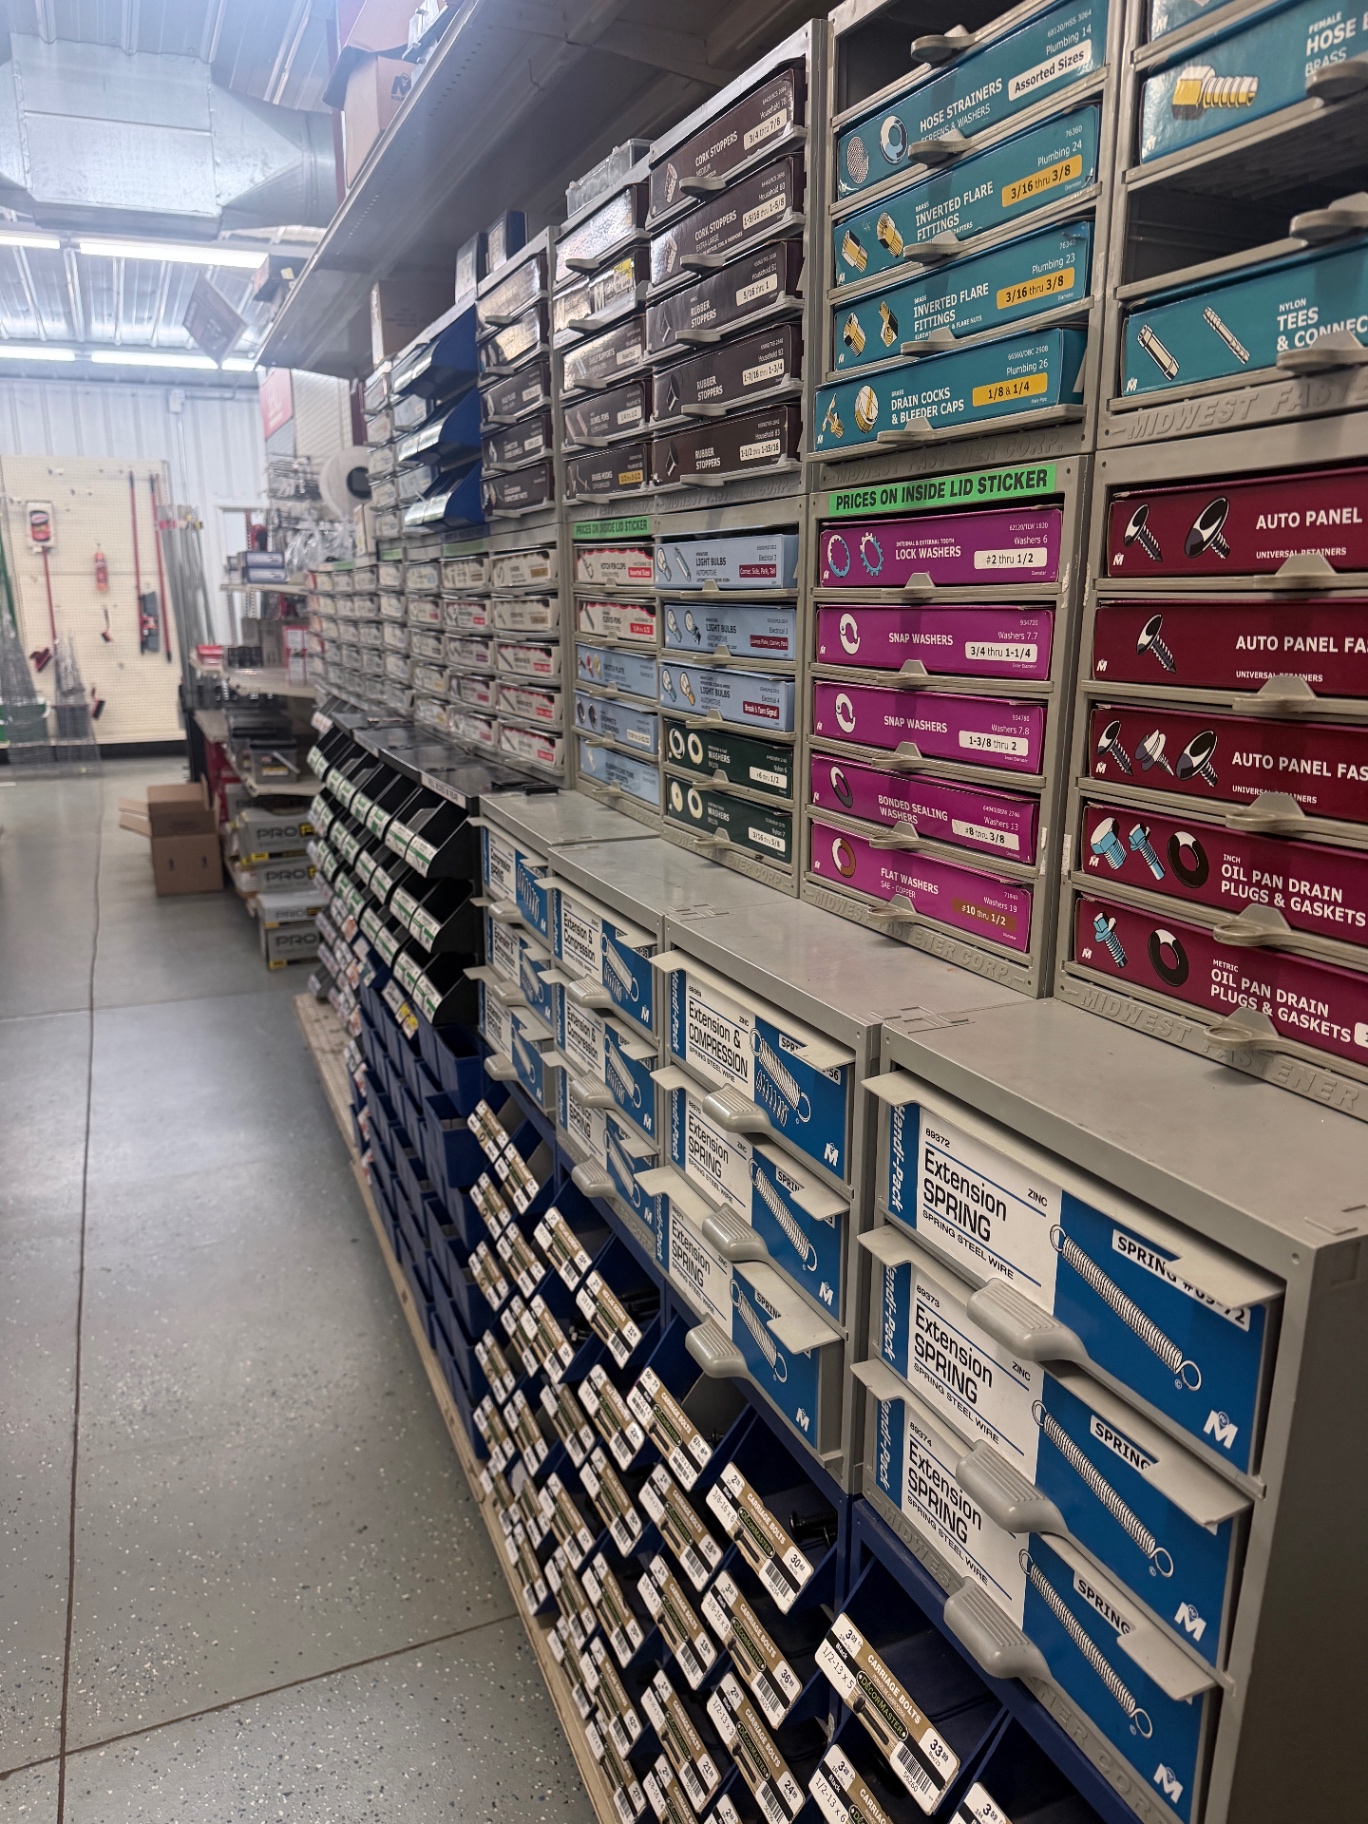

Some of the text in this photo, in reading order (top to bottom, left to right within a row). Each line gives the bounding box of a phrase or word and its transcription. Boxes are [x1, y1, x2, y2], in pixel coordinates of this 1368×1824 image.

[1309, 11, 1342, 34] FEMALE
[1046, 24, 1092, 55] Plumbing 14
[1306, 19, 1356, 56] HOSE
[1015, 50, 1084, 93] Assorted Sizes
[920, 78, 1002, 133] HOSE STRAINERS
[695, 131, 737, 167] CORK STOPPERS
[1037, 140, 1082, 166] Plumbing 24
[1011, 165, 1070, 199] 3/16 thru 3/8
[916, 181, 993, 227] INVERTED FLARE
[695, 211, 736, 240] CORK STOPPERS
[917, 213, 959, 241] FITTINGS
[1032, 253, 1075, 274] Plumbing 23
[914, 283, 989, 318] INVERTED FLARE
[1006, 275, 1064, 303] 3/16 thru 3/8
[691, 301, 710, 316] RUBBER
[1279, 298, 1306, 312] NYLON
[691, 309, 716, 328] STOPPERS
[914, 310, 955, 331] FITTINGS
[1277, 308, 1318, 331] TEES
[1007, 359, 1048, 376] Plumbing 26
[697, 376, 716, 390] RUBBER
[697, 386, 723, 401] STOPPERS
[989, 381, 1030, 399] 1/8 & 1/4
[892, 387, 950, 411] DRAIN COCKS
[892, 399, 964, 425] & BLEEDER CAPS
[1128, 396, 1258, 440] MIDWEST
[836, 469, 1048, 510] PRICES ON INSIDE LID STICKER
[624, 518, 647, 532] STICKER
[1256, 508, 1362, 530] AUTO PANEL
[896, 546, 961, 560] LOCK WASHERS
[1014, 536, 1048, 545] Washers 6
[696, 557, 726, 566] LIGHT BULBS
[986, 554, 1033, 565] #2 thru 1/2
[706, 623, 736, 633] LIGHT BULBS
[889, 633, 953, 646] SNAP WASHERS
[998, 631, 1024, 640] Washers
[971, 647, 1031, 659] 3/4 thru 1-1/4
[1236, 635, 1338, 653] AUTO PANEL
[884, 716, 948, 733] SNAP WASHERS
[969, 736, 1016, 751] 1-3/8 thru 2
[708, 750, 730, 764] WASHERS
[1232, 751, 1332, 778] AUTO PANEL
[708, 808, 730, 822] WASHERS
[878, 794, 948, 822] BONDED SEALING
[880, 806, 918, 825] WASHERS
[257, 826, 298, 839] PRO
[984, 816, 1018, 830] Washers 13
[1223, 853, 1241, 863] INCH
[266, 869, 306, 882] PRO
[881, 868, 938, 895] FLAT WASHERS
[1221, 863, 1343, 904] OIL PAN DRAIN
[962, 903, 1006, 926] #10 thru 1/2
[984, 896, 1018, 912] Washers 19
[1221, 880, 1366, 927] PLUGS & GASKETS
[277, 933, 317, 947] PRO
[1213, 959, 1239, 973] METRIC
[1211, 969, 1329, 1018] OIL PAN DRAIN
[689, 1000, 740, 1049] Extension &
[739, 1015, 749, 1027] ZINC
[1081, 989, 1192, 1045] MIDWEST
[1211, 985, 1351, 1044] PLUGS & GASKETS
[689, 1022, 748, 1078] COMPRESSION
[689, 1114, 729, 1165] Extension
[925, 1127, 950, 1149] 89372
[689, 1136, 722, 1179] SPRING
[924, 1147, 1007, 1223] Extension
[1028, 1187, 1048, 1207] ZINC
[923, 1178, 991, 1242] SPRING
[922, 1210, 1014, 1281] SPRING STEEL WIRE
[916, 1284, 940, 1309] 89373
[915, 1303, 993, 1389] Extension
[914, 1334, 977, 1404] SPRING
[914, 1361, 999, 1445] SPRING STEEL WIRE
[909, 1421, 933, 1448] 89374
[908, 1439, 982, 1531] Extension
[747, 1493, 786, 1545] CARRIAGE BOLTS
[907, 1467, 969, 1546] SPRING
[1078, 1578, 1131, 1634] SPRING
[822, 1646, 844, 1676] 1/2-13
[847, 1680, 854, 1689] 5
[867, 1654, 921, 1725] CARRIAGE BOLTS
[861, 1675, 903, 1736] DÉCORMASTER
